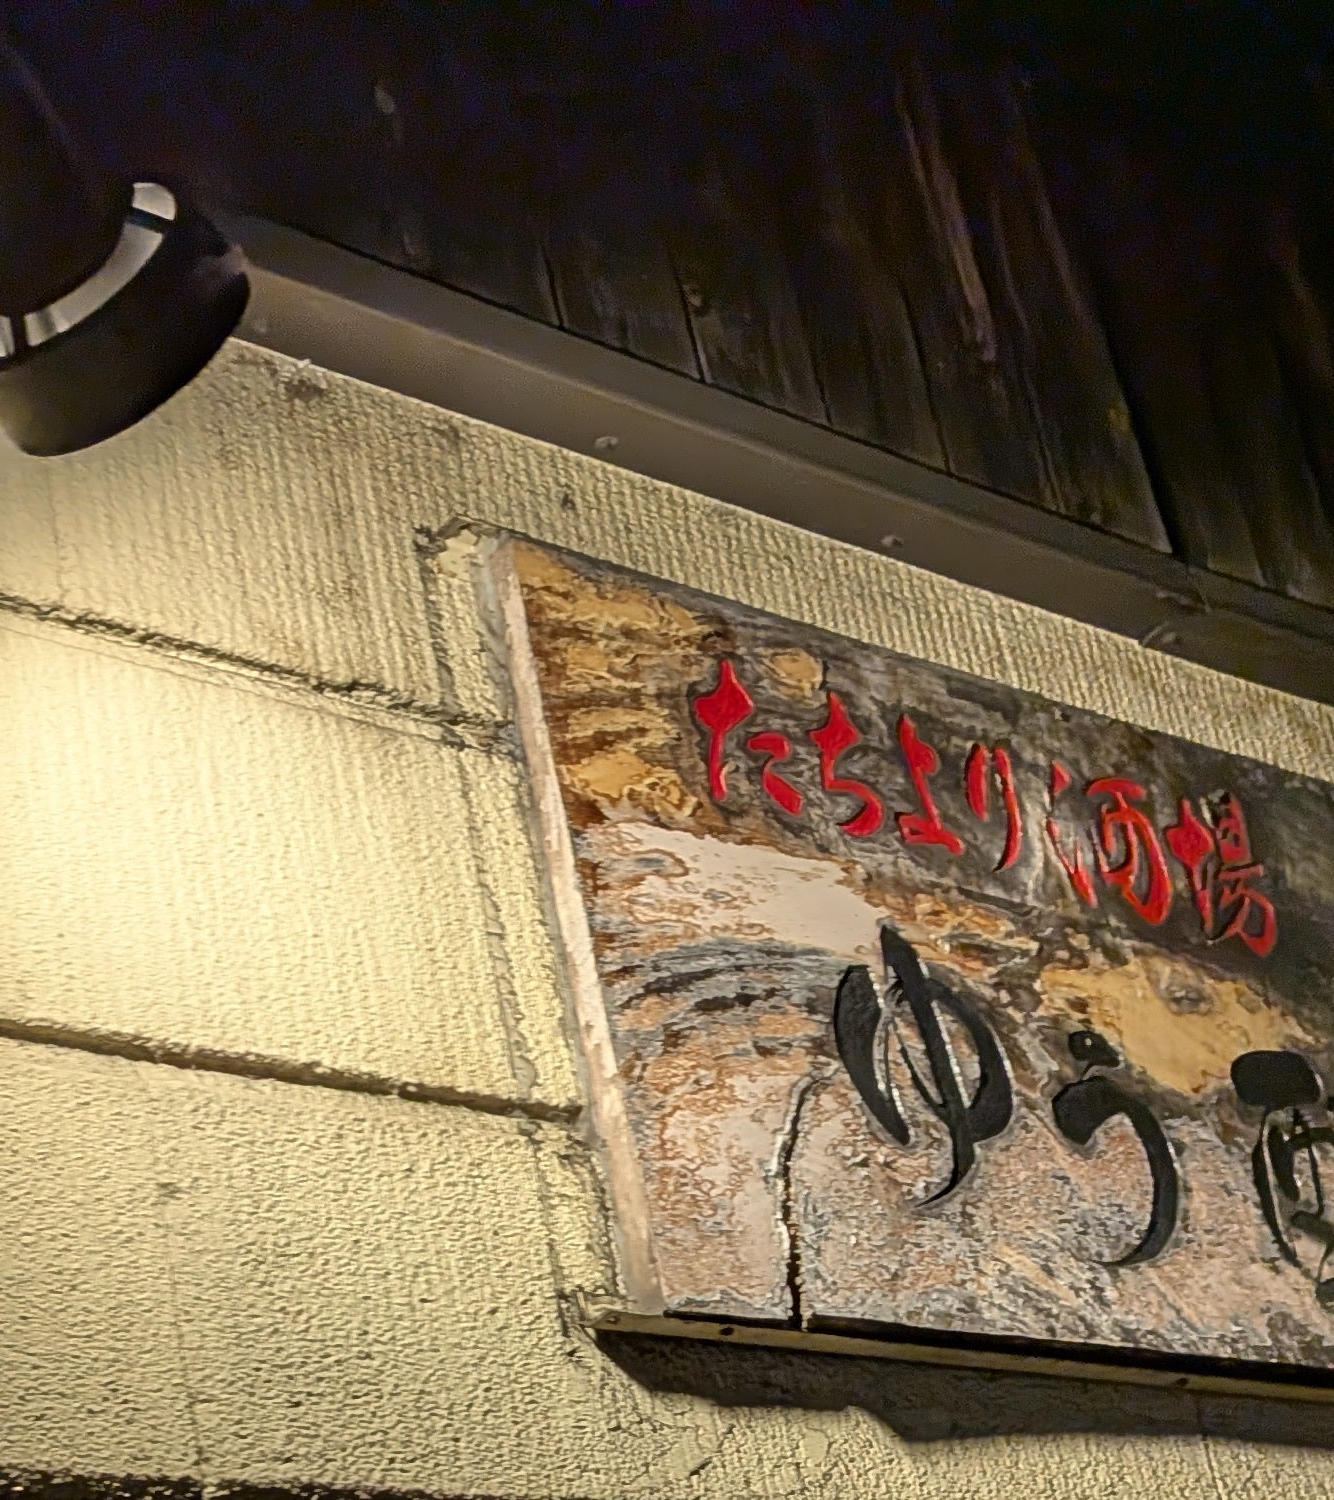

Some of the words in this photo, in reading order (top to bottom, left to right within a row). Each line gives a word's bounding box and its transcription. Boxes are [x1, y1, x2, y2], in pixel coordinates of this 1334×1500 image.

[692, 658, 1277, 957] たちより酒場
